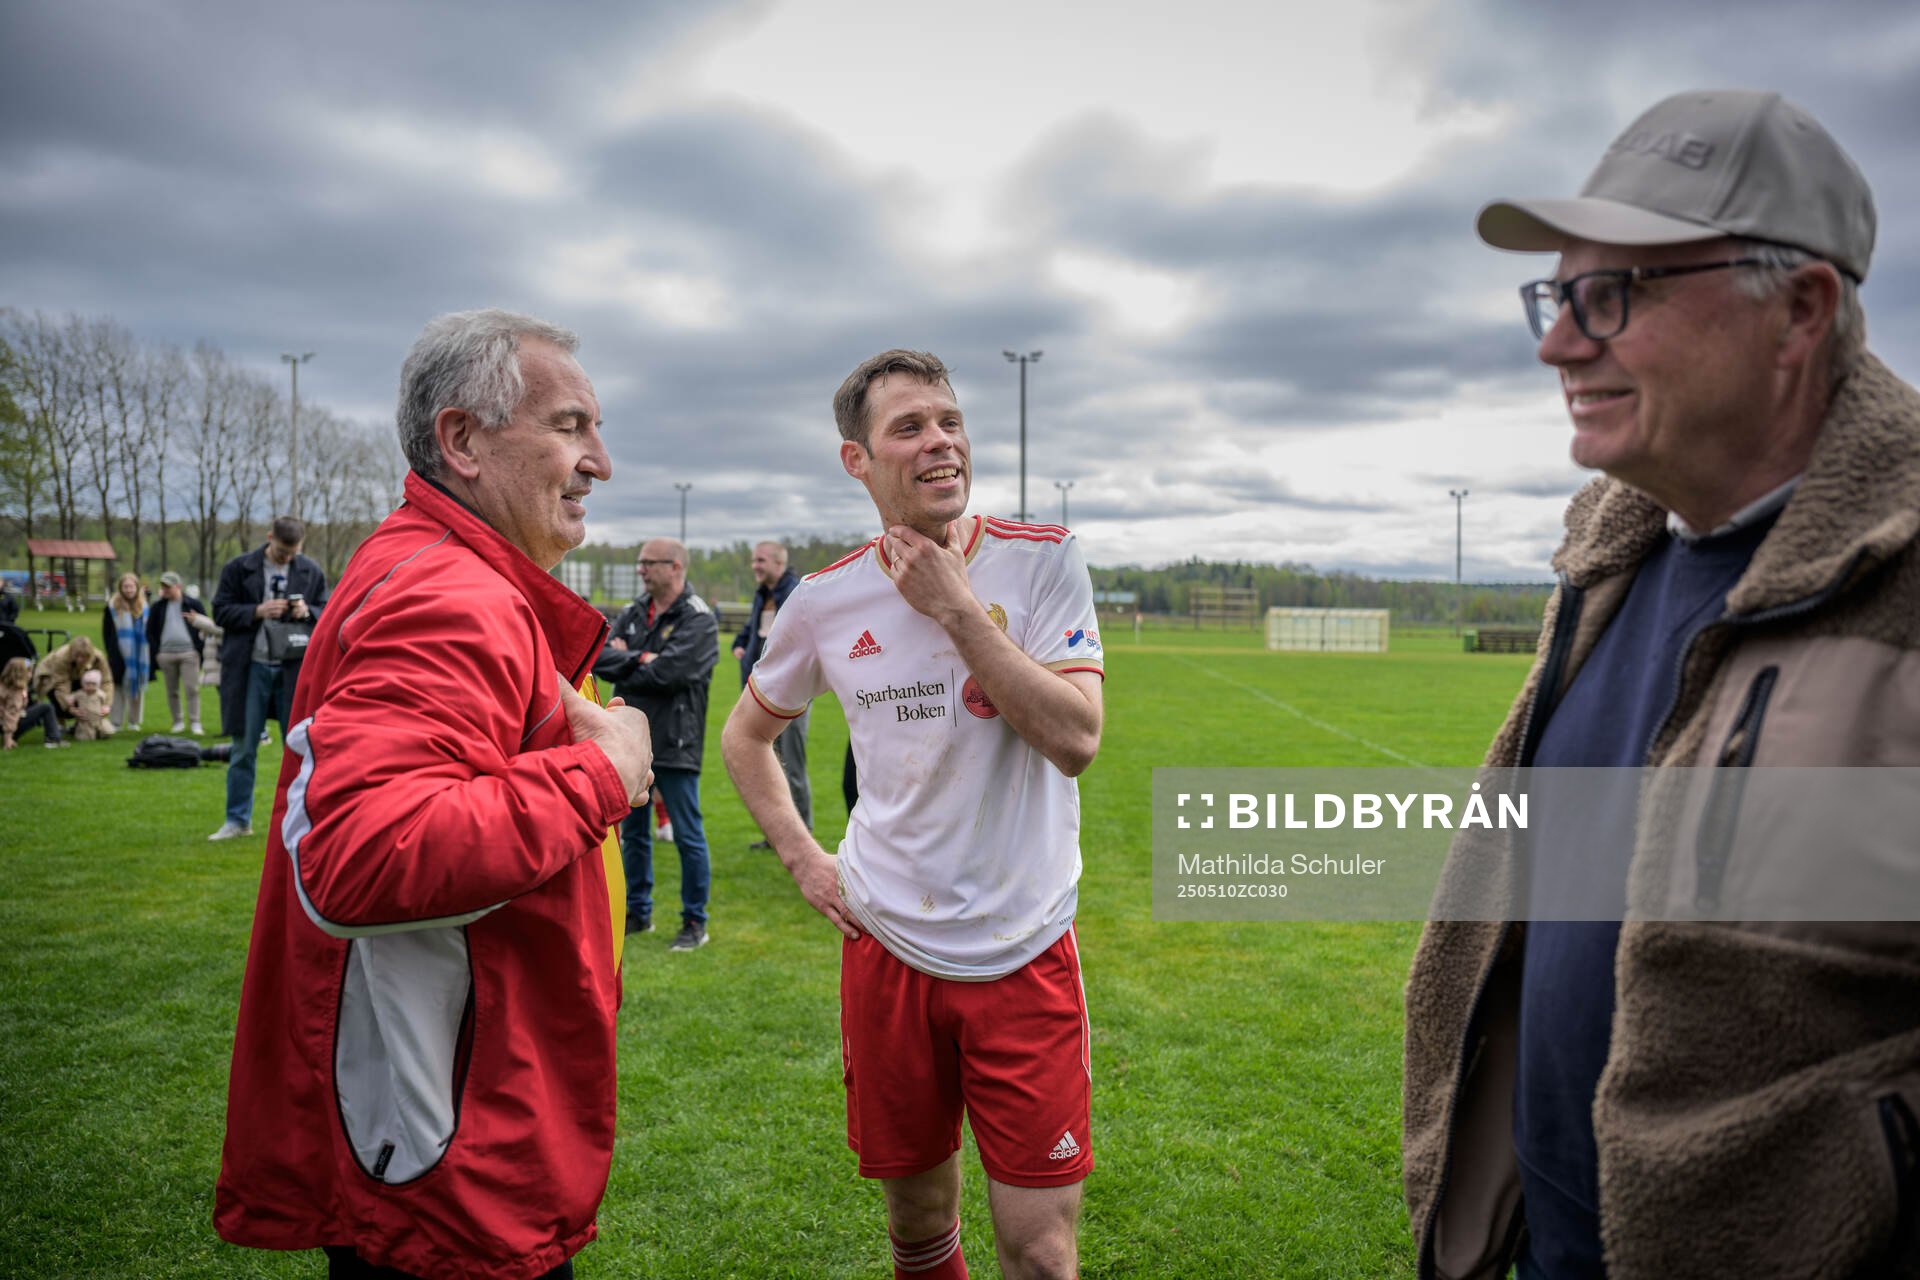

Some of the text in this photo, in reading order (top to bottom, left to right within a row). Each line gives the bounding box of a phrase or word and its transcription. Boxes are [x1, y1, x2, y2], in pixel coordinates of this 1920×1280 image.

[849, 645, 882, 659] adidas
[856, 681, 945, 709] Sparbanken
[896, 703, 946, 722] Boken
[1049, 1145, 1080, 1160] adidas
